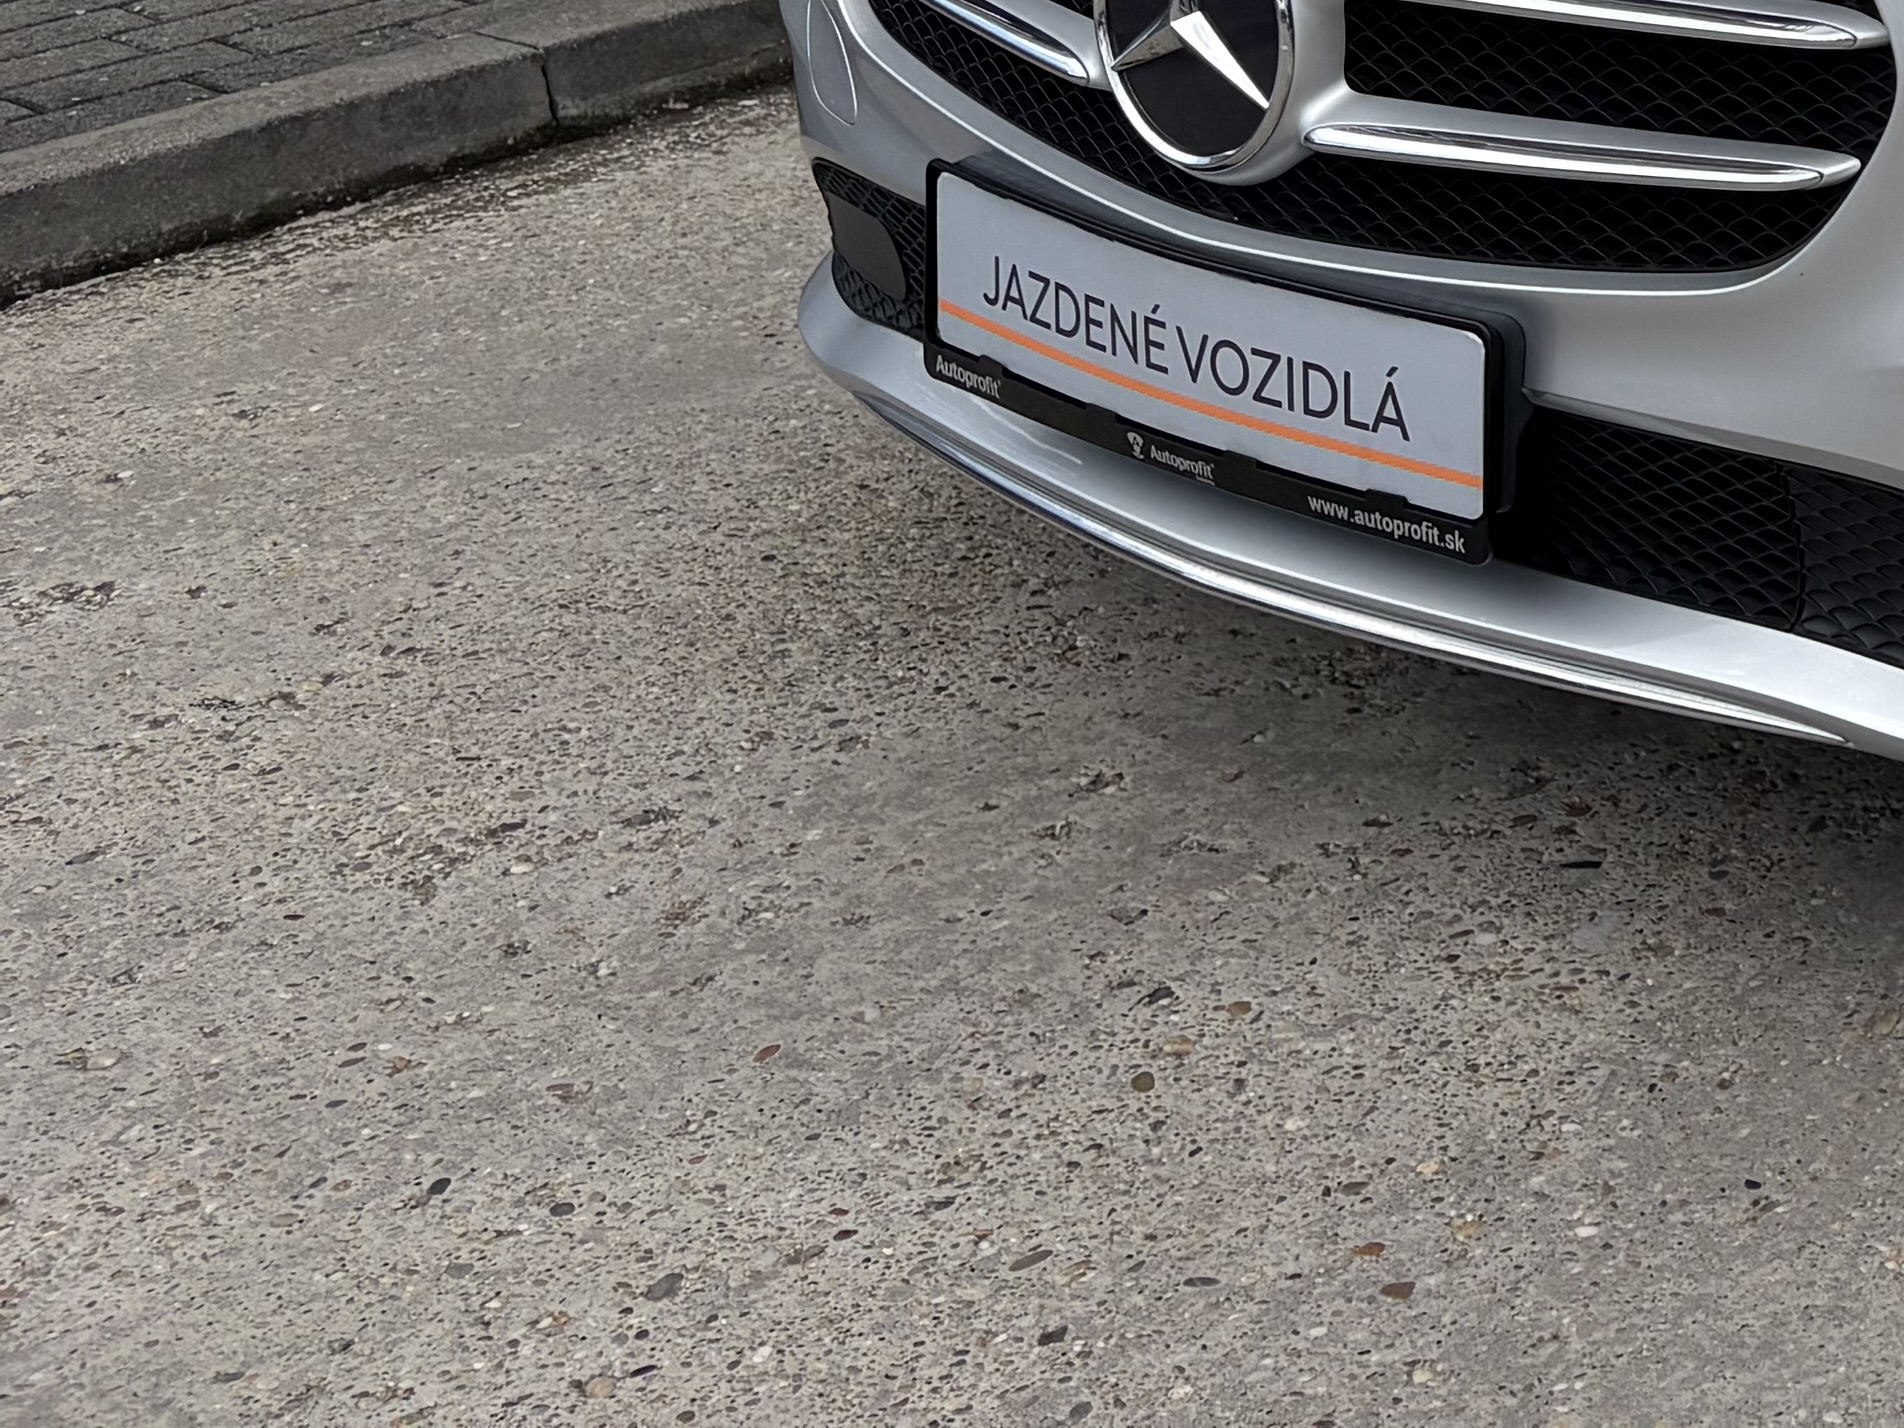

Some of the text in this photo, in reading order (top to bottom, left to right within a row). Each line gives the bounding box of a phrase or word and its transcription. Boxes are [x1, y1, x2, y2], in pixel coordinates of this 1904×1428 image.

[982, 255, 1411, 442] JAZDENÉ VOZIDLÁ
[936, 354, 1001, 399] Autoprofit
[1150, 444, 1214, 480] Autoprofit
[1307, 495, 1466, 554] www.autoprofit.sk
